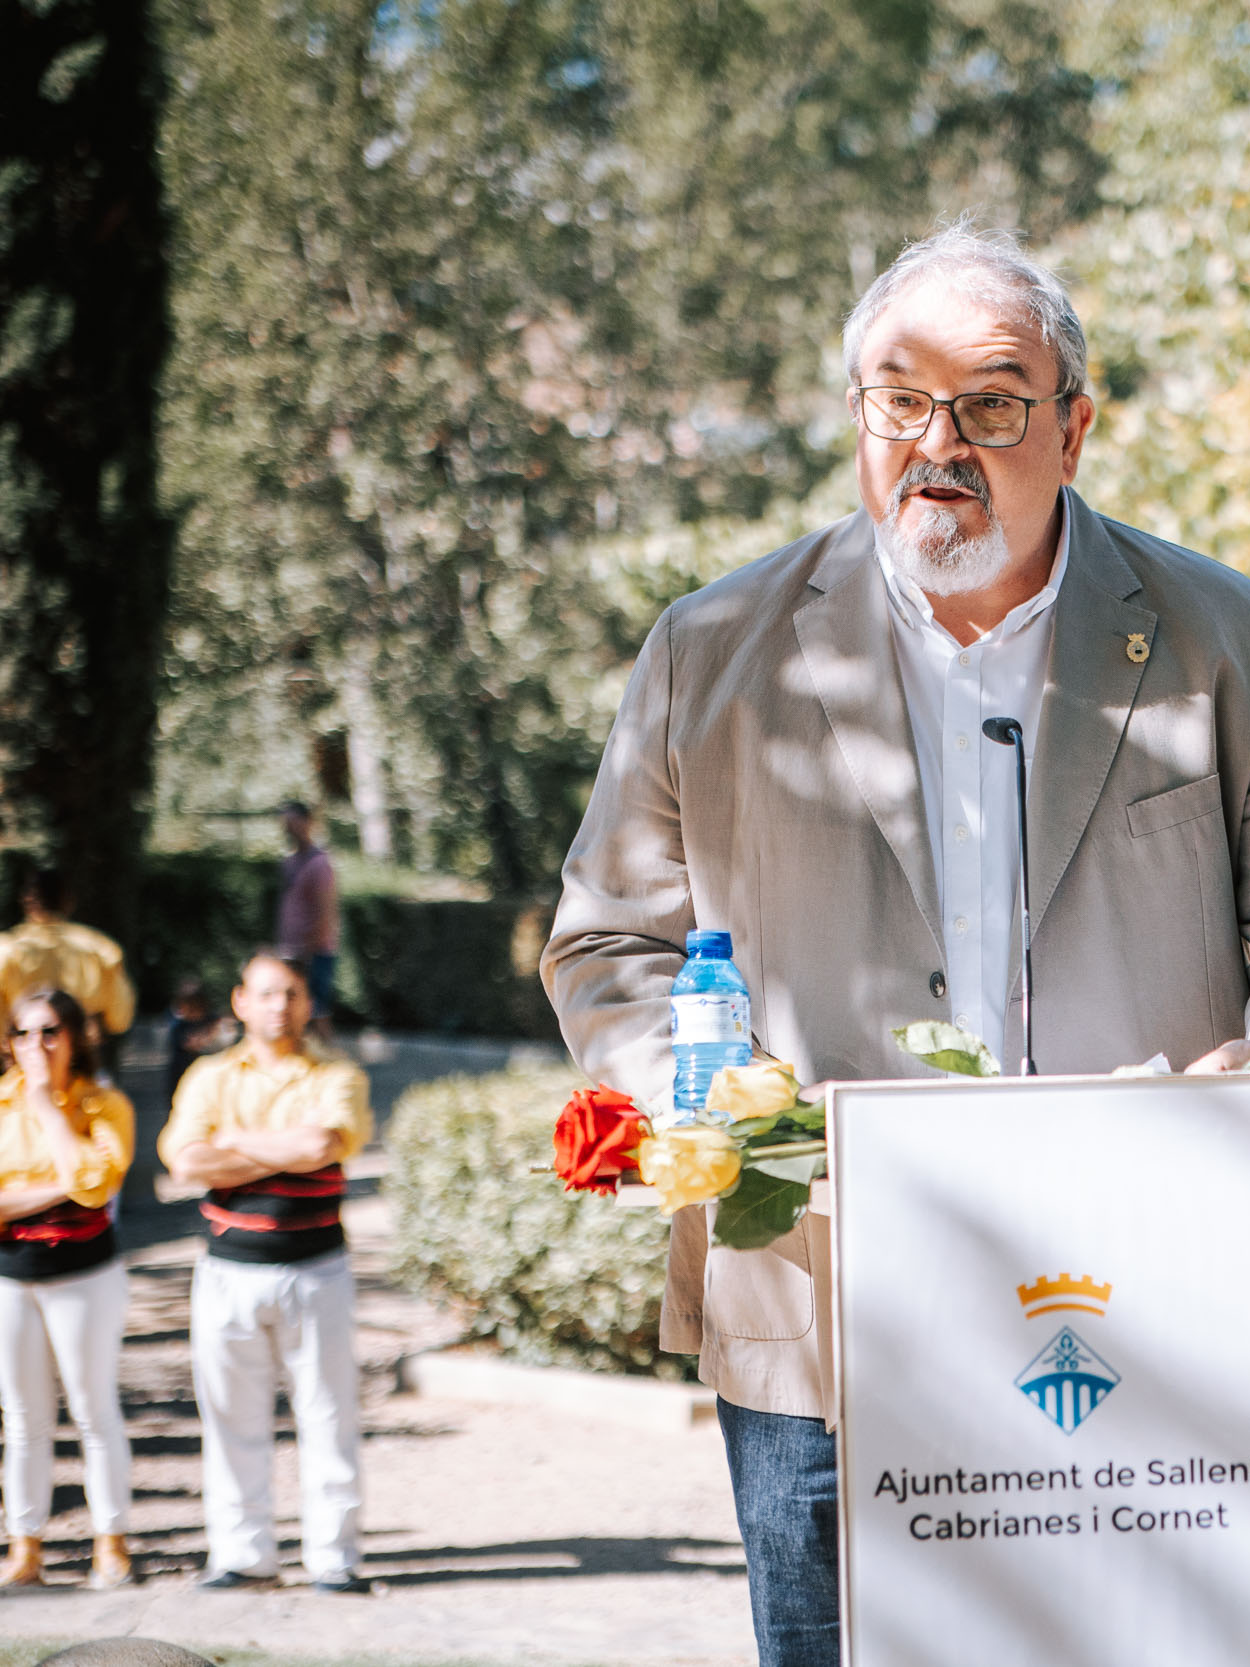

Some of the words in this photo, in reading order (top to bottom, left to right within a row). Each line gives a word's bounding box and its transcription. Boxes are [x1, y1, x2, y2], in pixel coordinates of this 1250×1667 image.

[874, 1464, 1083, 1504] Ajuntament
[1094, 1461, 1136, 1489] de
[908, 1509, 1082, 1542] Cabrianes
[1092, 1505, 1099, 1533] i
[1111, 1503, 1229, 1533] Cornet
